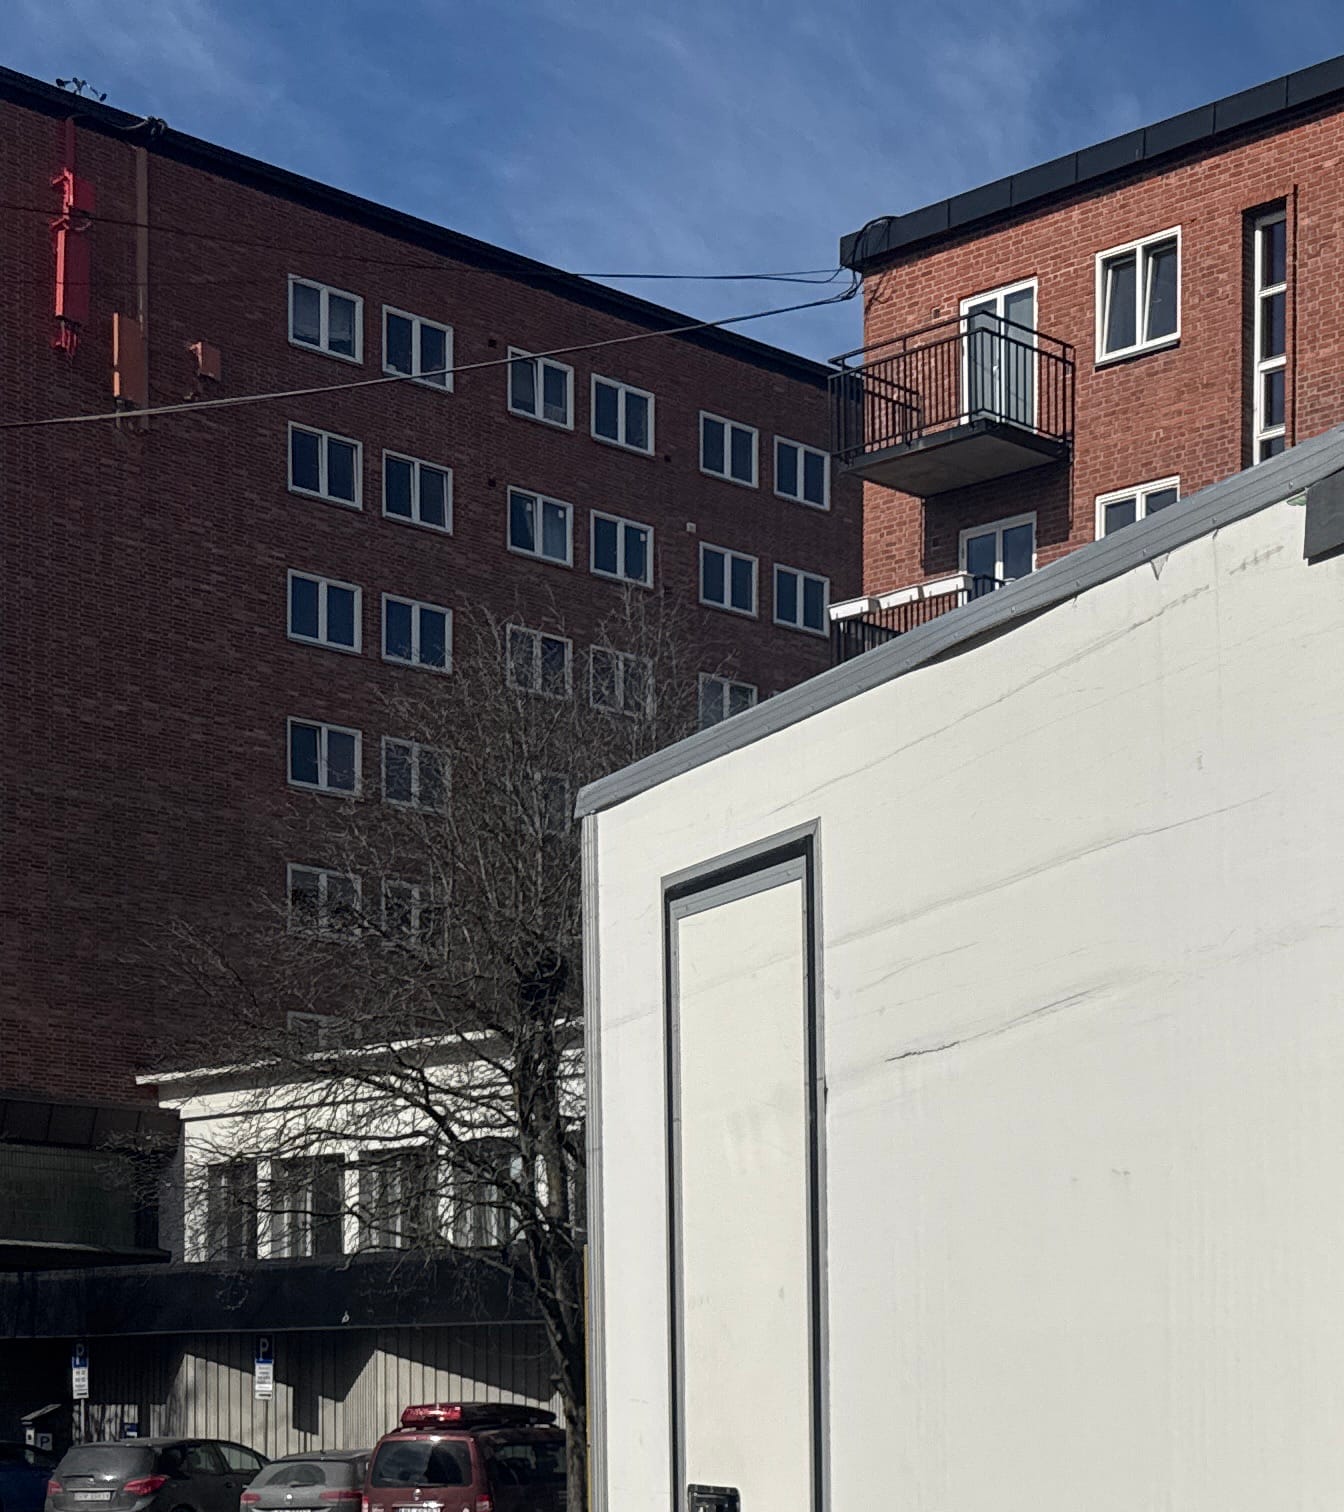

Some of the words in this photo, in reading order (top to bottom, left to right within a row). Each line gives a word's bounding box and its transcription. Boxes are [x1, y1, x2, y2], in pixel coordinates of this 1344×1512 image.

[75, 1343, 84, 1365] P
[259, 1337, 269, 1361] P
[41, 1436, 50, 1449] P
